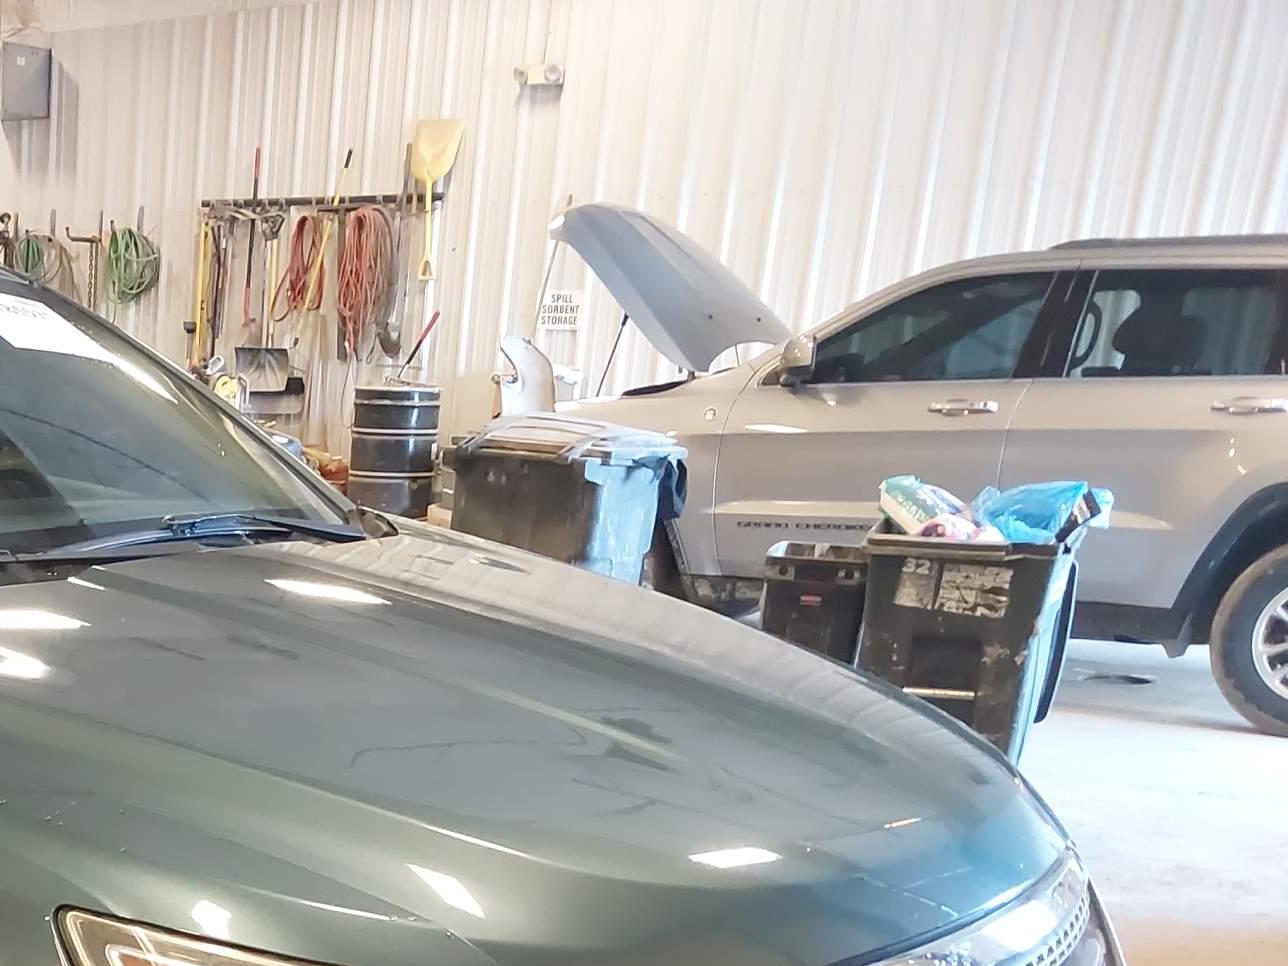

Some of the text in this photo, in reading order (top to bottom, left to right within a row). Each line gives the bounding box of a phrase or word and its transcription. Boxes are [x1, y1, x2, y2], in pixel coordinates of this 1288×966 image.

[551, 294, 573, 304] SPILL
[542, 304, 580, 315] SORBENT
[541, 315, 578, 325] STORAGE
[901, 557, 931, 575] 32
